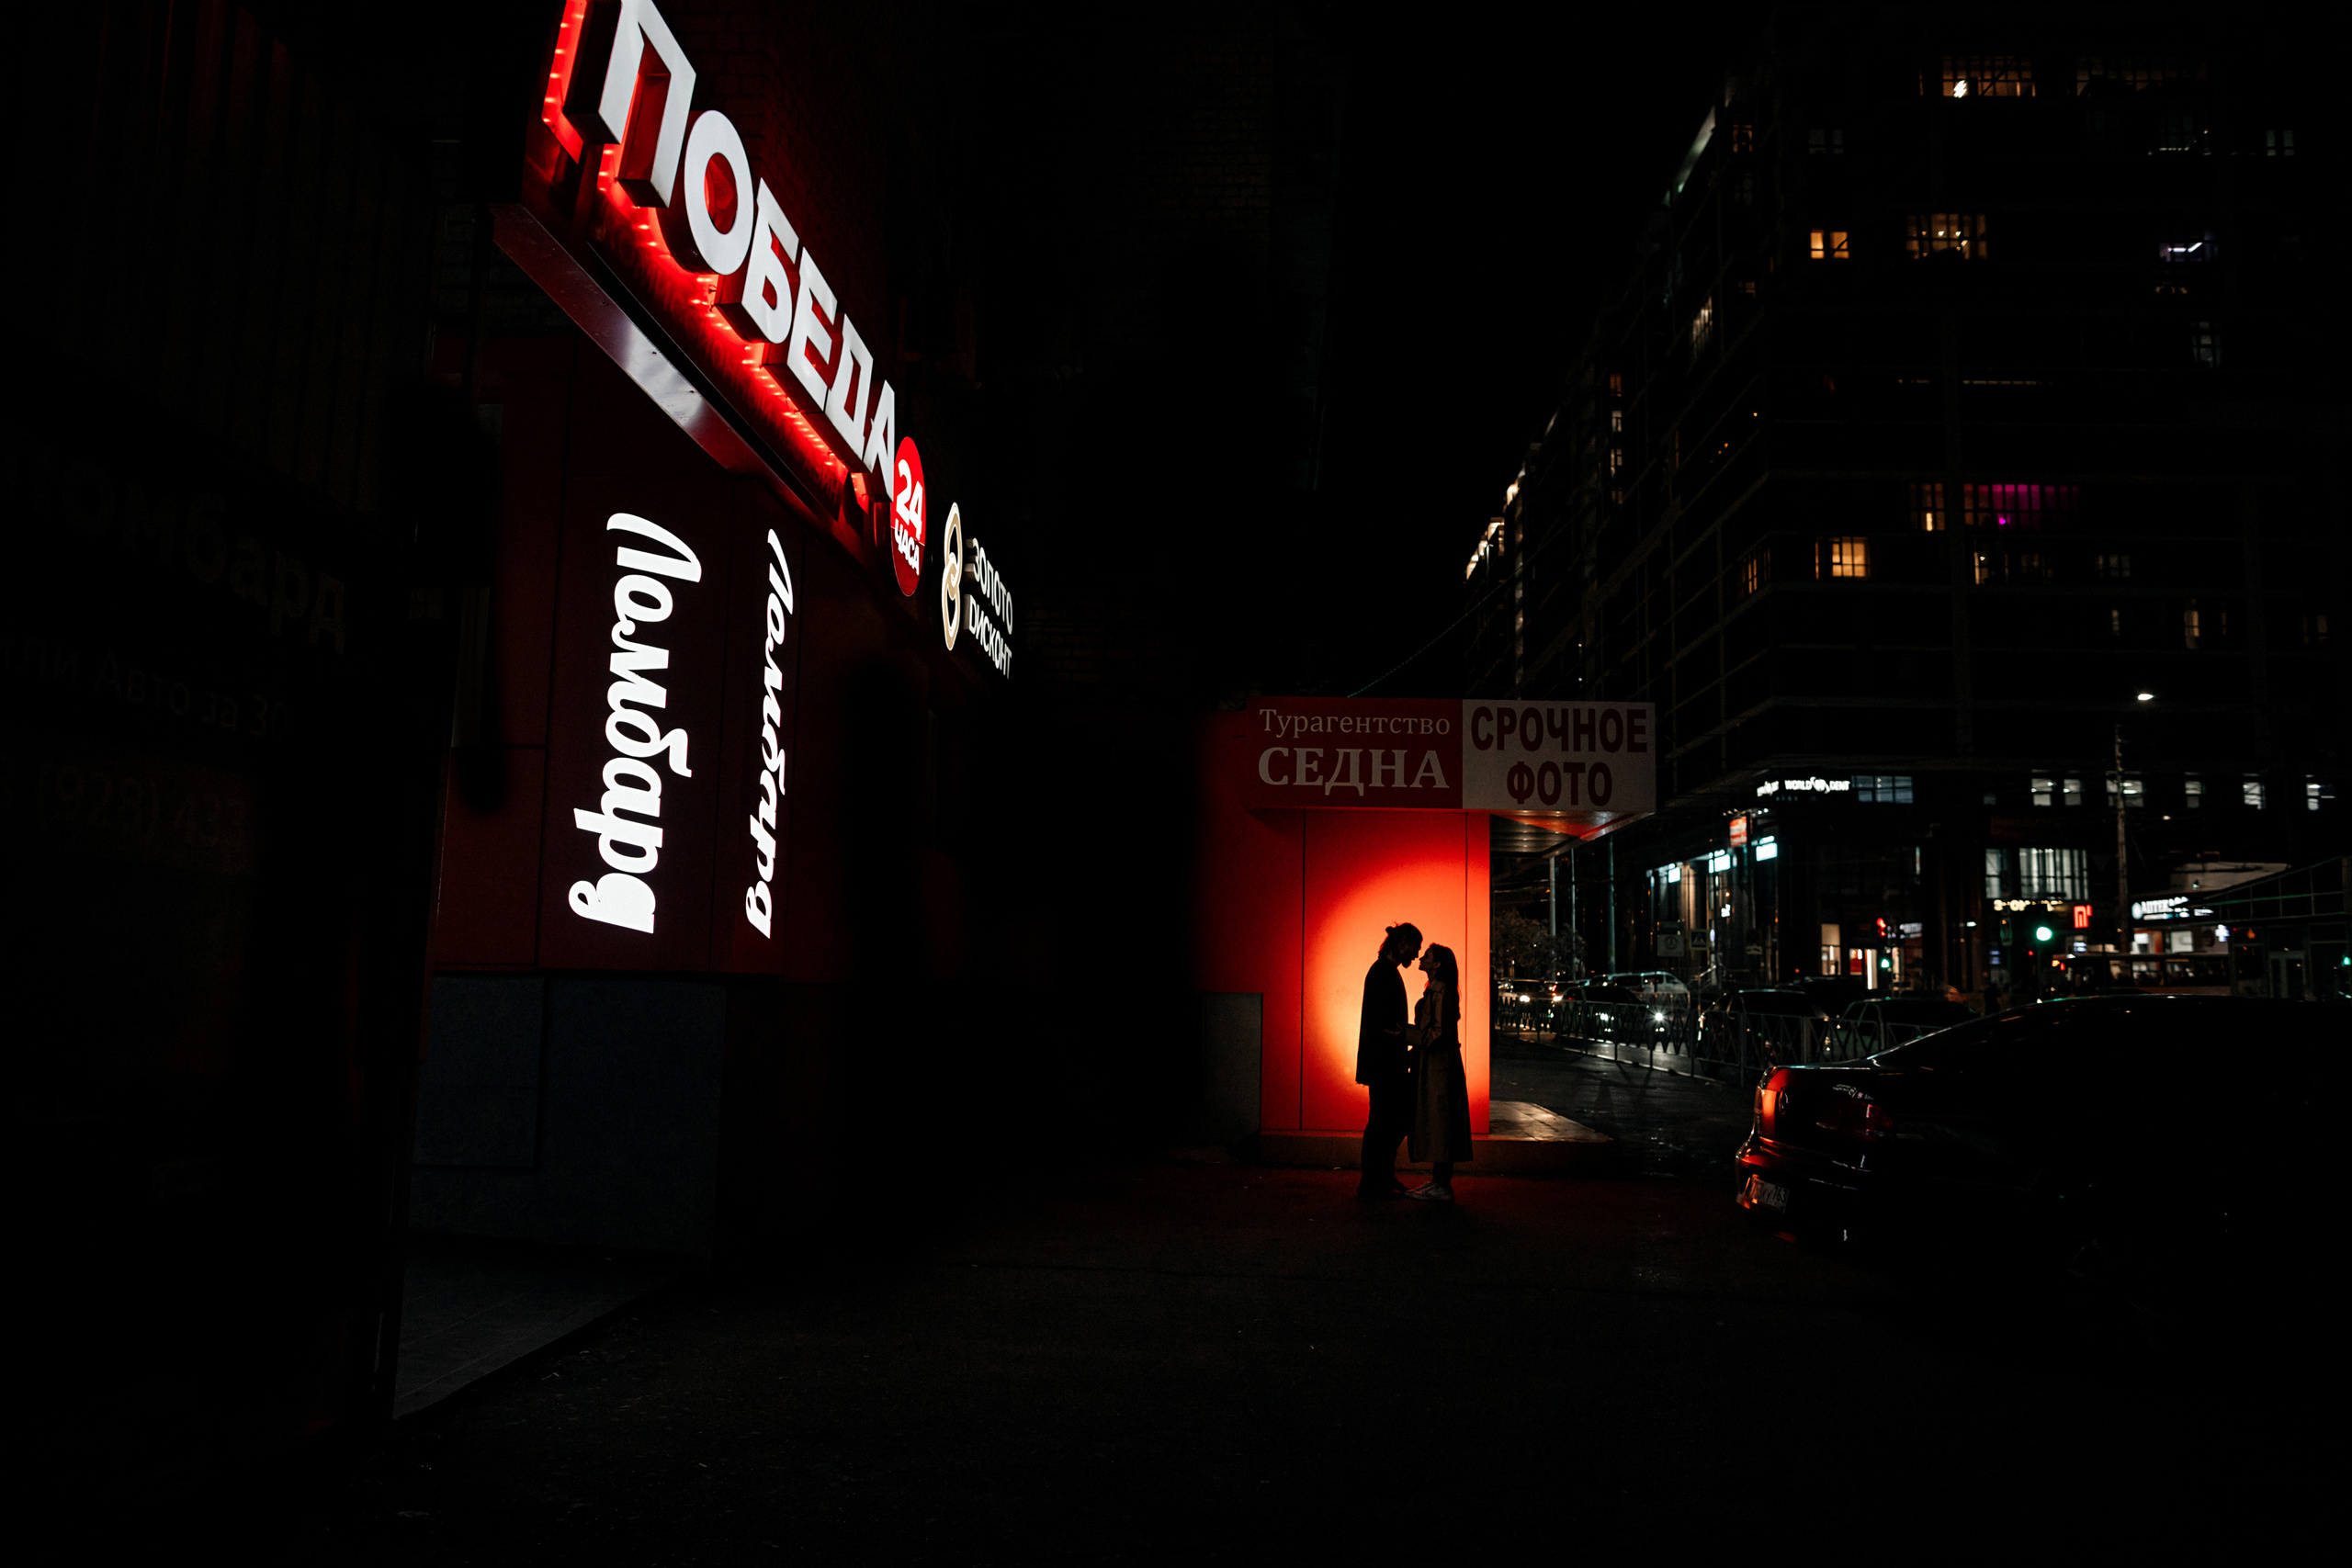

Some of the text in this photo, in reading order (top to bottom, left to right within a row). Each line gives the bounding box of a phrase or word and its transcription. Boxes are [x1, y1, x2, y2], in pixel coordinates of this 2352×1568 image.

[599, 0, 896, 502] ПОБЕДА
[896, 459, 923, 540] 24
[894, 518, 921, 575] ЧАСА
[973, 537, 1013, 634] ЗОЛОТО
[569, 513, 702, 934] Ломбард
[745, 529, 794, 939] Ломбард
[1259, 708, 1451, 738] Турагентство
[1470, 705, 1648, 753] СРОЧНОЕ
[1258, 746, 1450, 796] СЕДНА
[1507, 761, 1612, 807] ФОТО
[1784, 779, 1813, 791] WORLD
[1829, 780, 1850, 792] DENT
